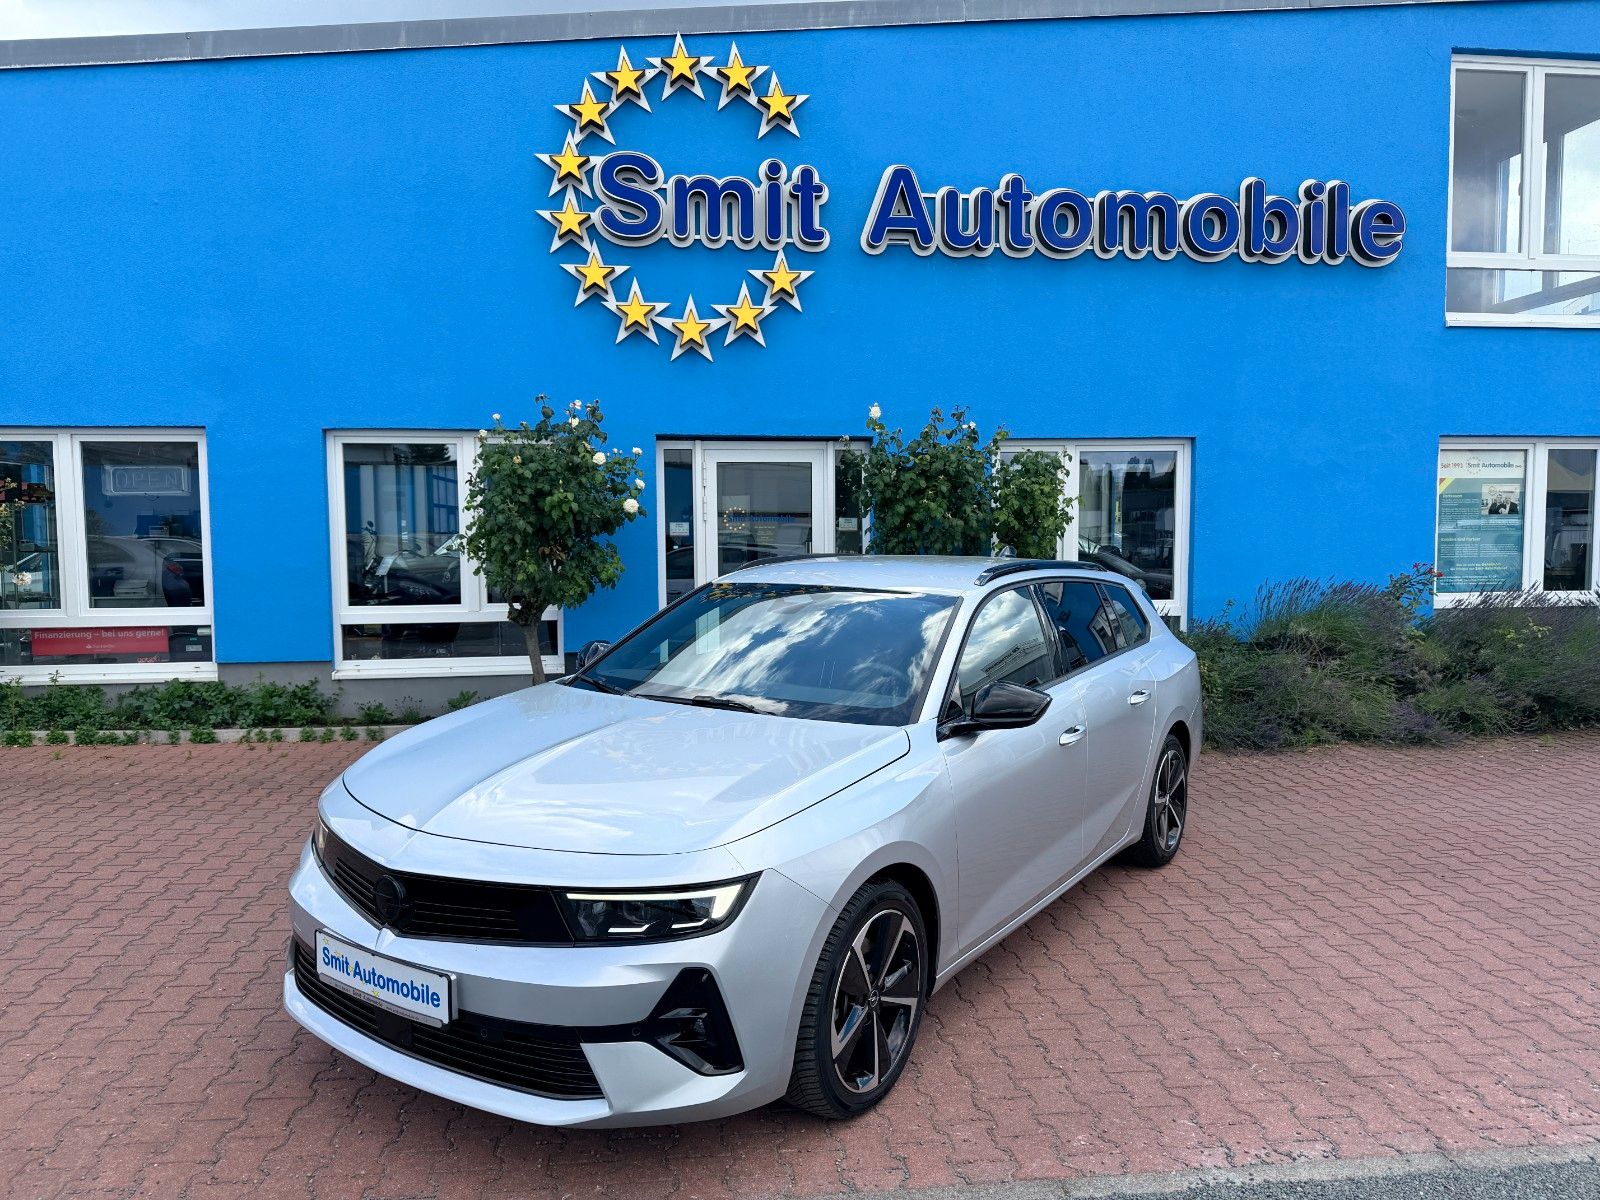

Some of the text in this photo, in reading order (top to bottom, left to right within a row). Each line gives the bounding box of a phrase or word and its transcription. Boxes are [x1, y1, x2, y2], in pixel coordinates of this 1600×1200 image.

[596, 152, 1406, 264] Smit Automobile
[1481, 461, 1514, 469] Automobile
[115, 471, 177, 489] OPEN
[34, 631, 92, 641] Finanzierung
[102, 630, 115, 638] bei
[135, 628, 164, 639] gerne!
[322, 946, 351, 976] Smit
[352, 961, 441, 1009] Automobile
